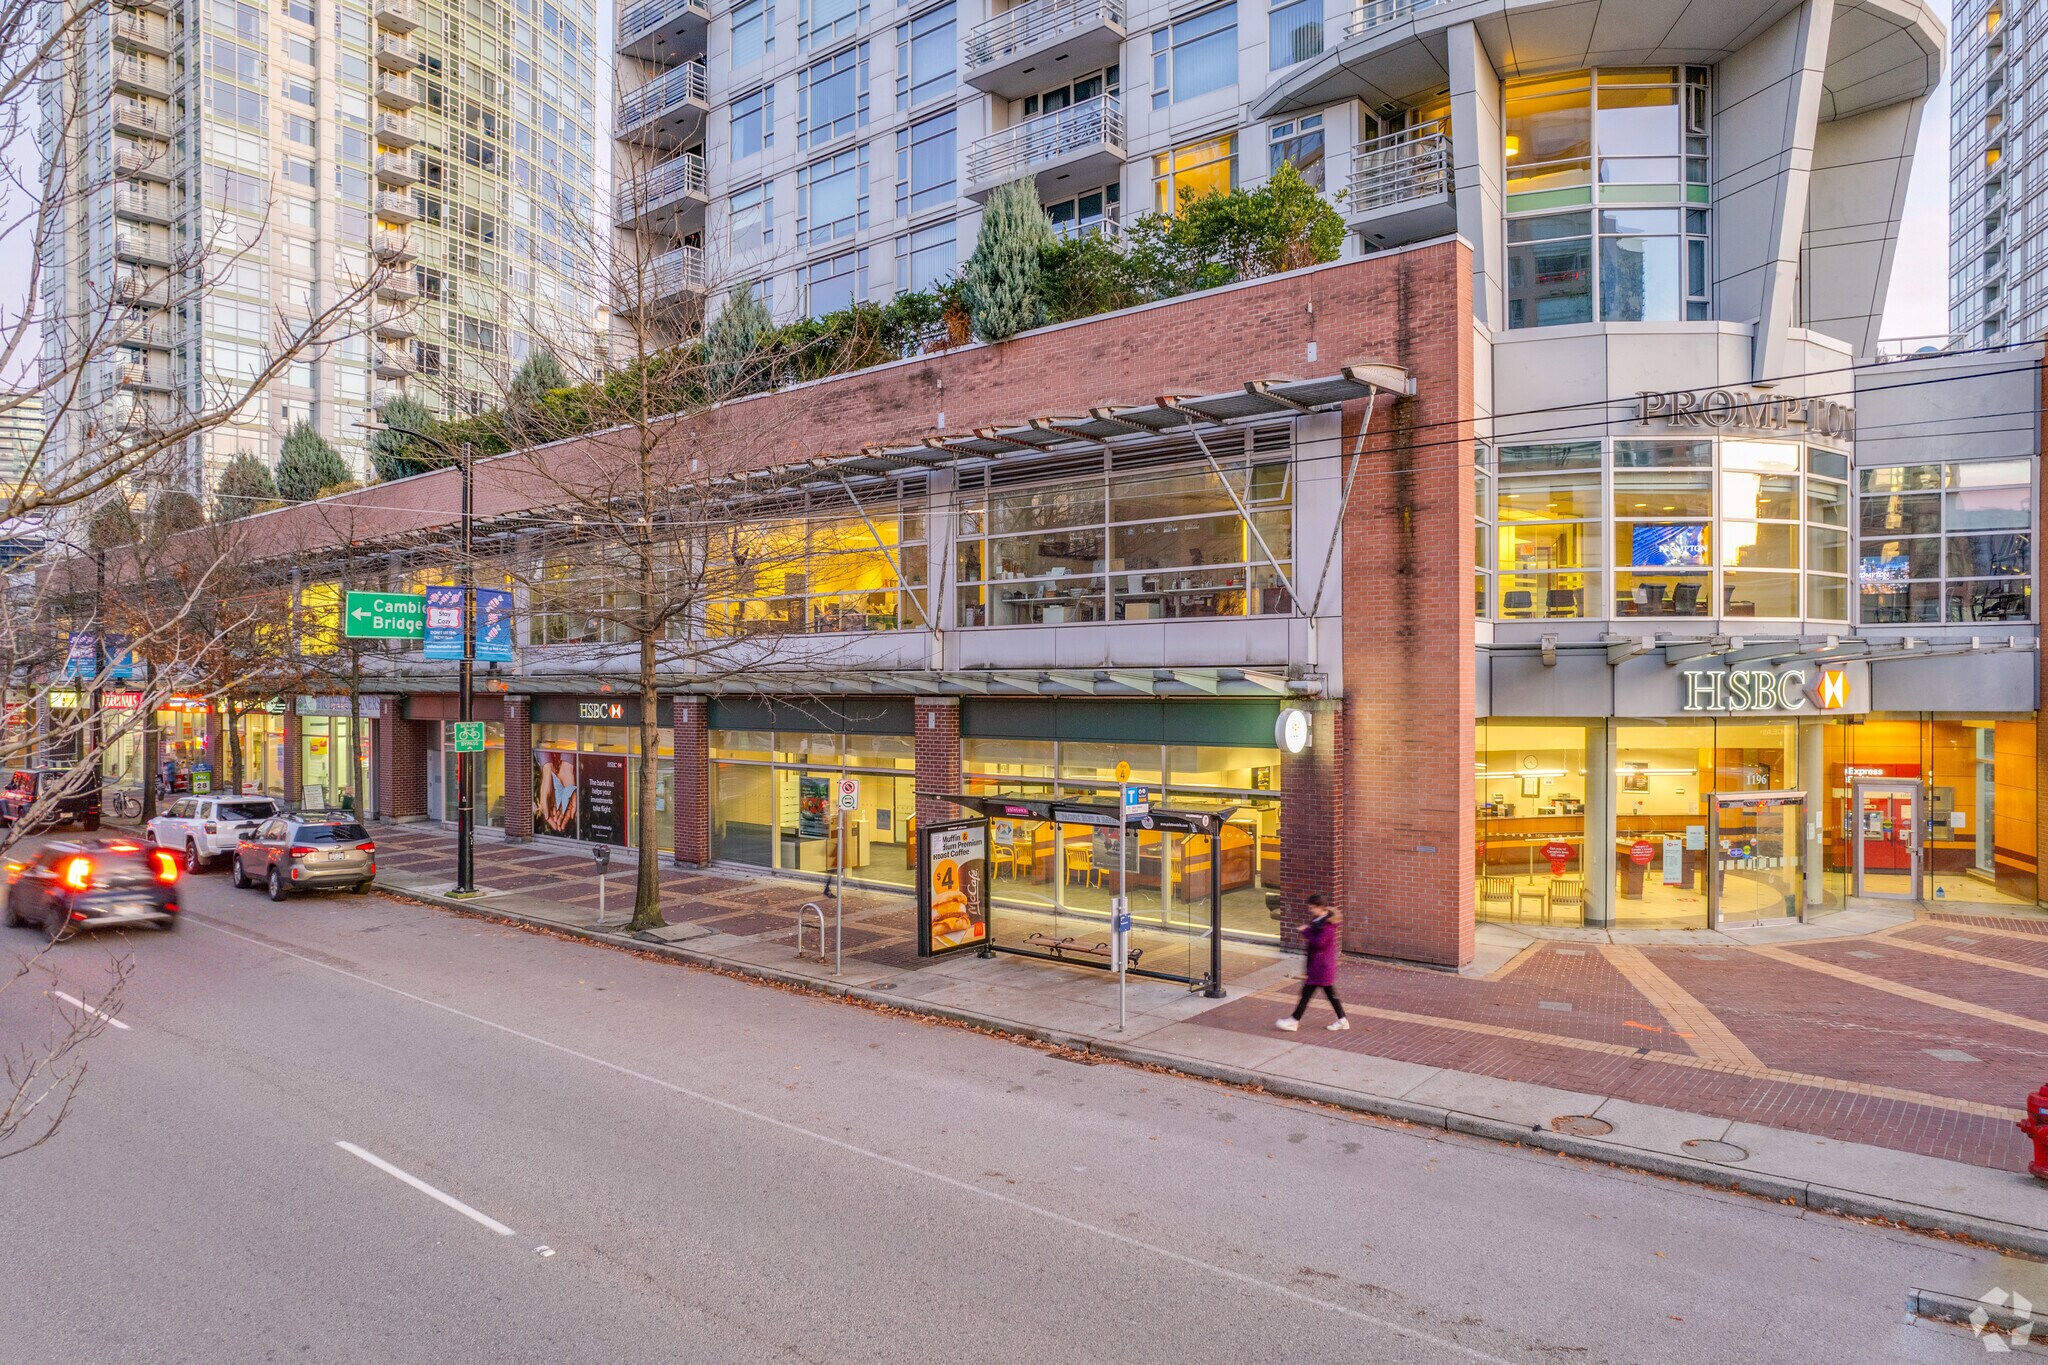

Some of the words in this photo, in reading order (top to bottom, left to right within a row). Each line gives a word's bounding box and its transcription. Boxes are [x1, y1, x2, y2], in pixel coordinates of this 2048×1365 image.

[1635, 390, 1856, 441] PROMPTON
[1658, 545, 1708, 553] PROMPTON
[373, 616, 423, 633] Bridge
[1683, 670, 1806, 711] HSBC
[580, 703, 608, 719] HSBC
[1120, 770, 1125, 779] 4
[1848, 767, 1884, 776] Express
[1747, 774, 1767, 784] 1196
[1127, 790, 1135, 803] T
[957, 839, 983, 849] Premium
[950, 848, 970, 857] Coffee
